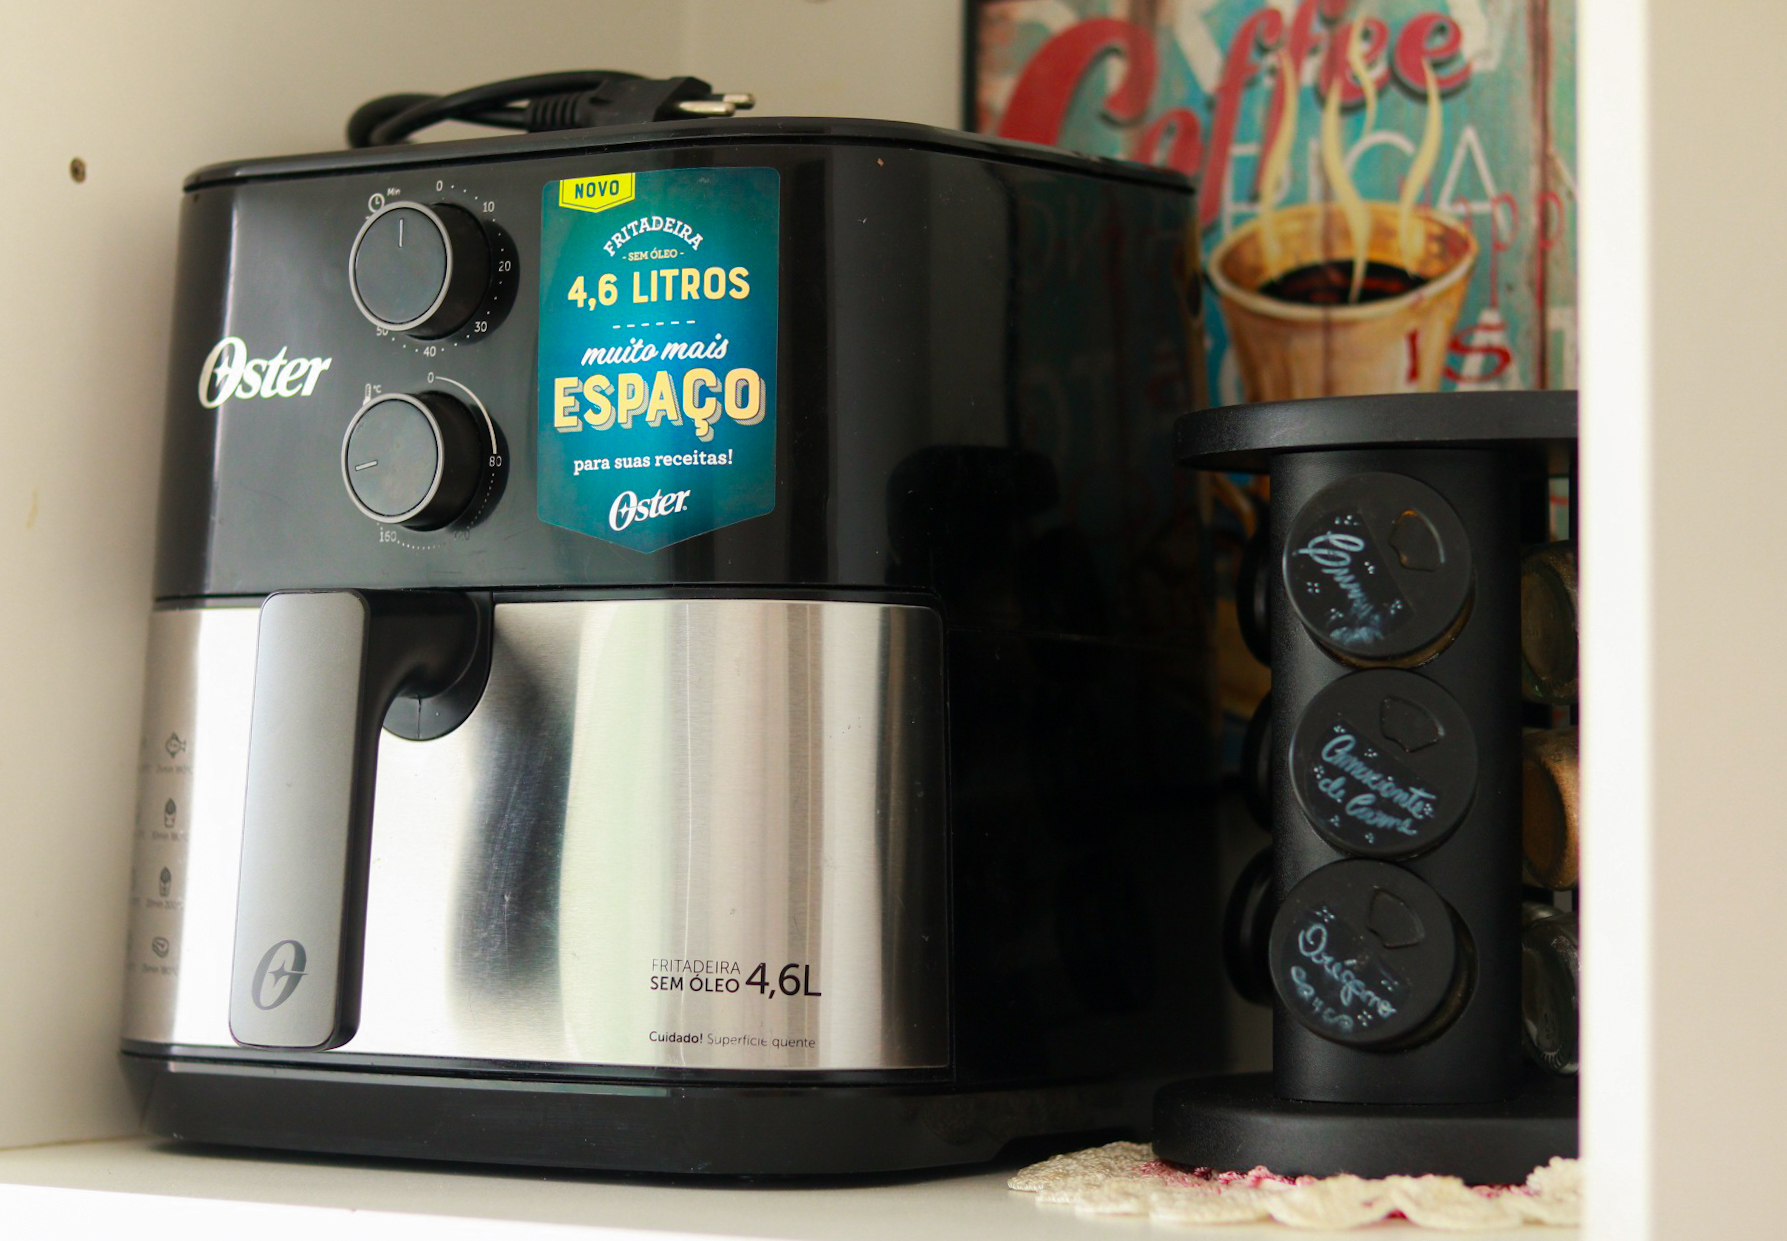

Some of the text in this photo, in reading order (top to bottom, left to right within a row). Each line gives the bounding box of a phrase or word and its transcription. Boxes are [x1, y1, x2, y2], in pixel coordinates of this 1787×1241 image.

[436, 180, 443, 192] 0
[575, 180, 620, 199] NOVO
[482, 201, 495, 213] 10
[603, 216, 704, 257] FRITADEIRA
[628, 247, 678, 262] SEM ÓLEO
[498, 260, 511, 272] 20
[567, 266, 750, 311] 4,6 LITROS
[474, 321, 487, 333] 30
[423, 346, 436, 357] 40
[580, 333, 729, 366] muito mais
[198, 336, 333, 409] Oster
[427, 372, 435, 383] 0
[554, 367, 766, 443] ESPAÇO
[488, 456, 502, 467] 80
[573, 449, 734, 476] para suas receitas!
[652, 958, 741, 975] FRITADEIRA
[650, 962, 822, 999] SEM ÓLEO 4,6L
[649, 1031, 703, 1044] Cuidado!
[772, 1036, 816, 1049] quente
